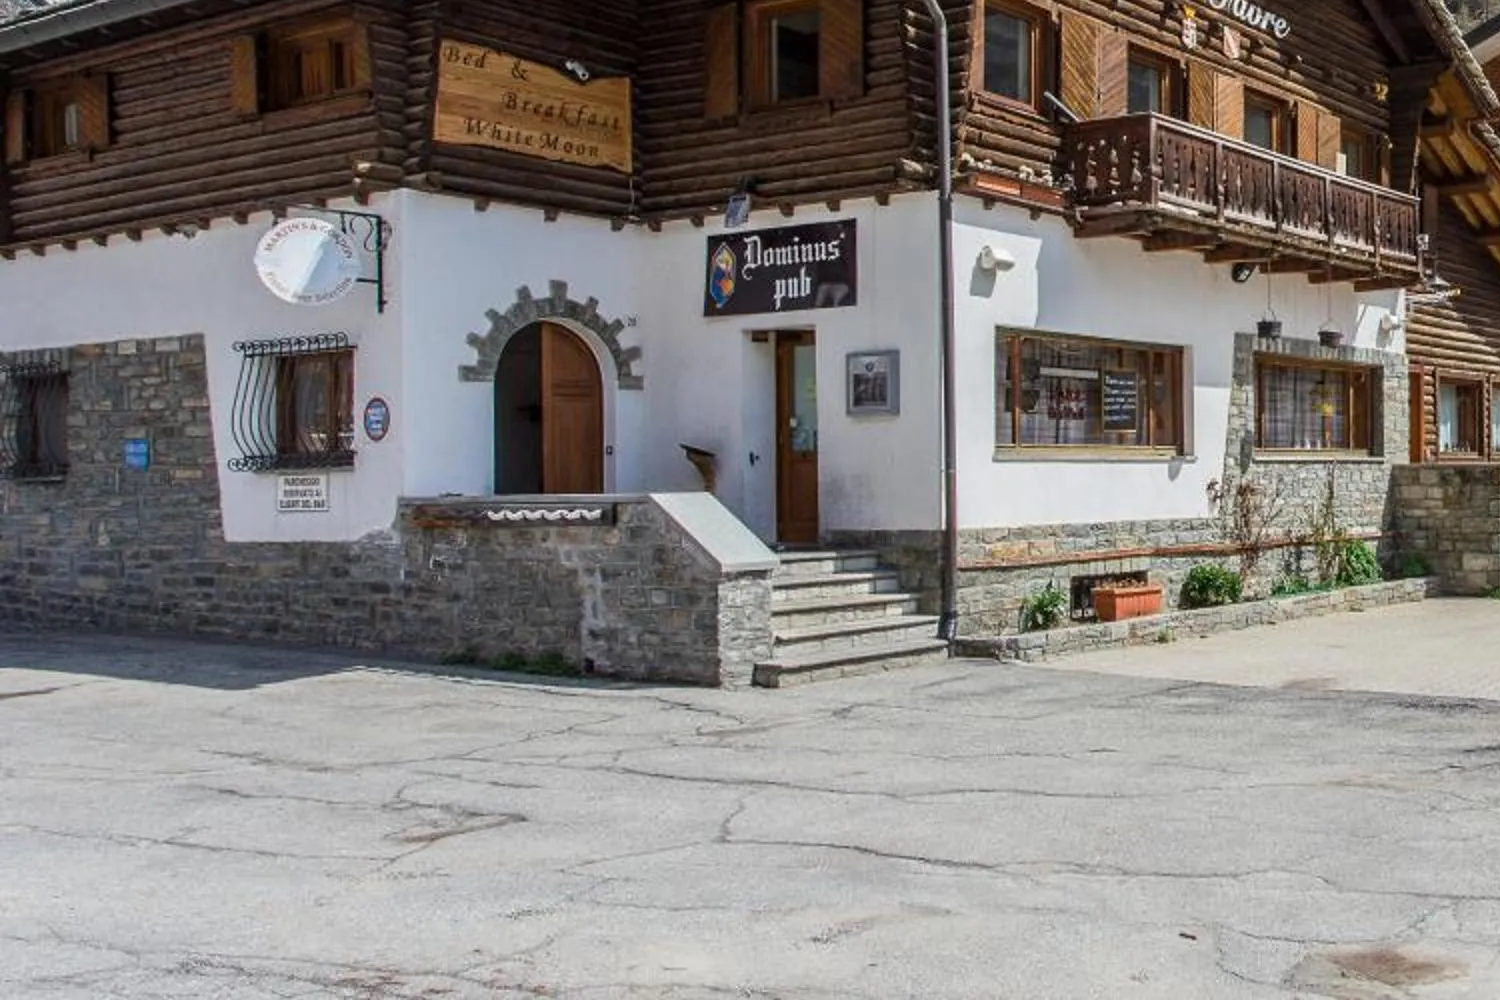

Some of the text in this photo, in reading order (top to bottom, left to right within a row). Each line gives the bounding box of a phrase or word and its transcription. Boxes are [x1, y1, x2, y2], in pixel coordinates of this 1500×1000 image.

[443, 48, 529, 82] Bed &
[502, 91, 620, 131] Breakfast
[464, 117, 600, 158] White Moon
[773, 267, 812, 311] pub
